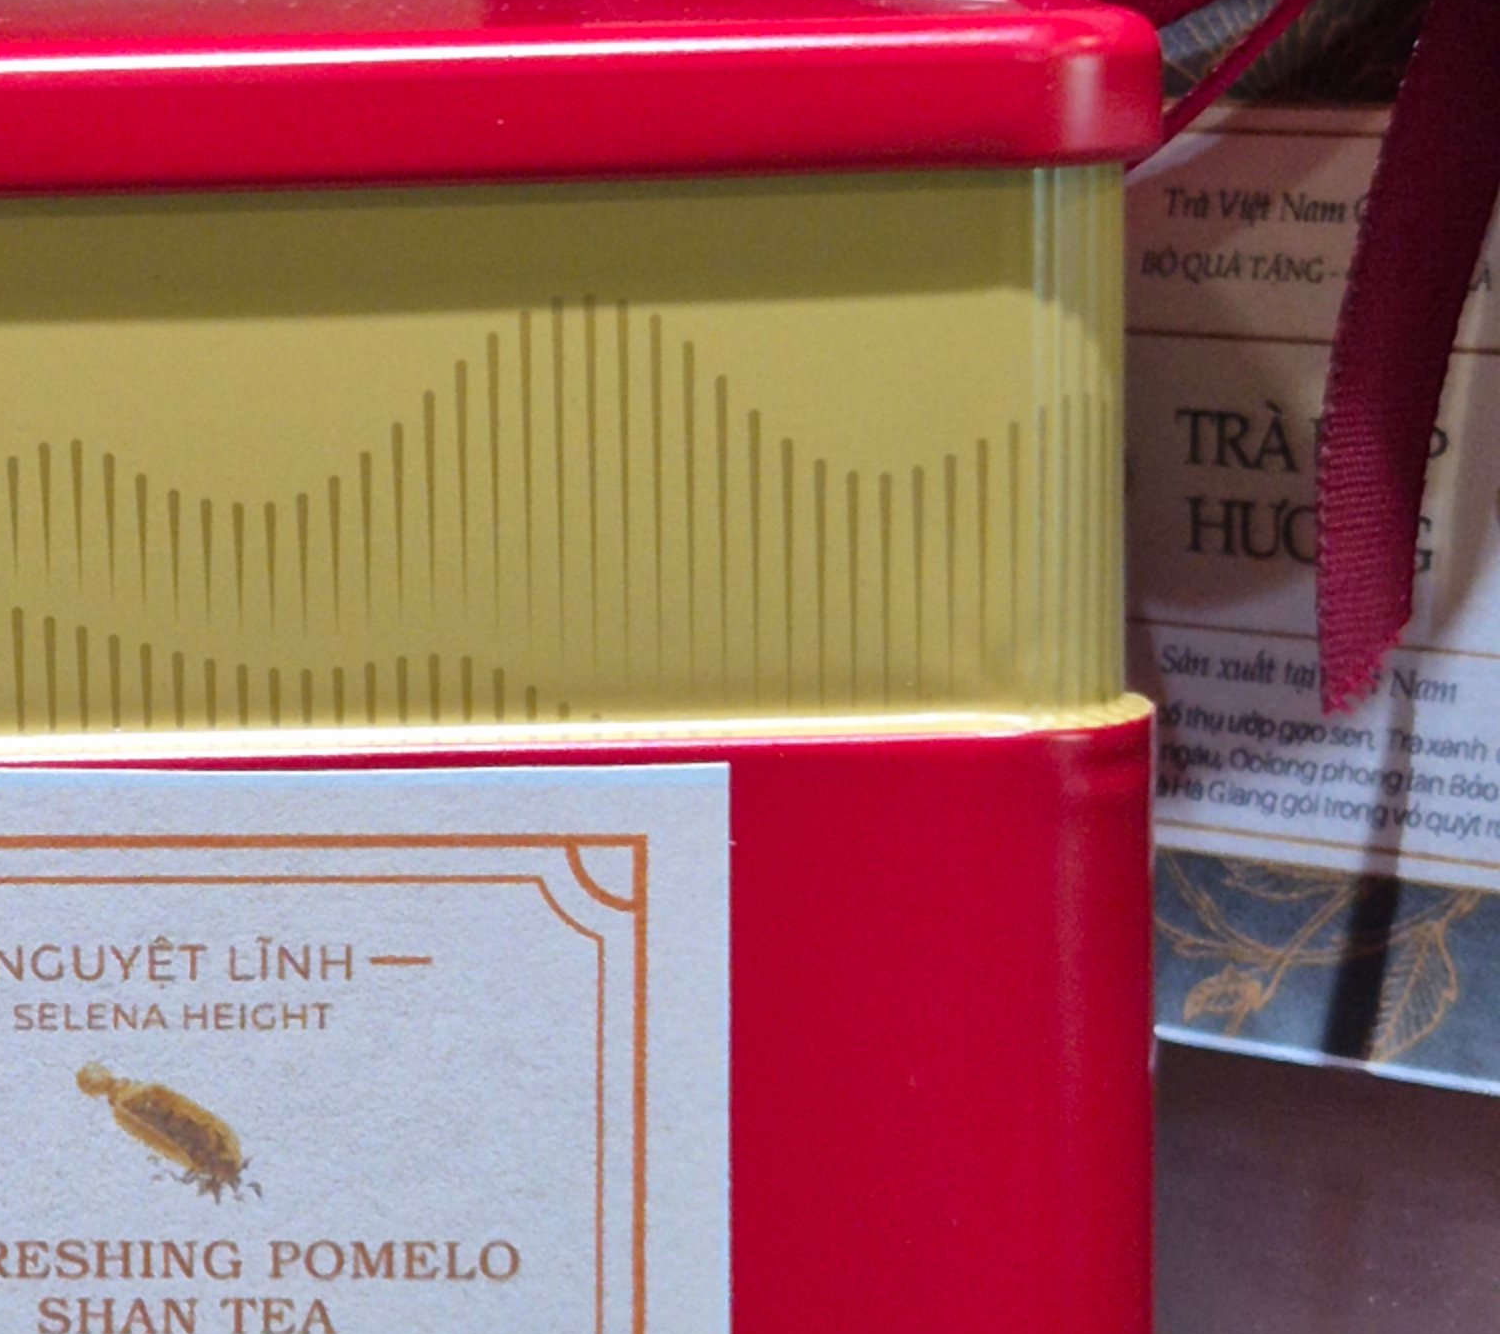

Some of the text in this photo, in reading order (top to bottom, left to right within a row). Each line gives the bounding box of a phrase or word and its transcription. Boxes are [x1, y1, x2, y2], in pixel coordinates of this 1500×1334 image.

[1219, 190, 1270, 226] Việt
[1279, 192, 1345, 224] Nam
[1174, 400, 1296, 472] TRÀ
[1216, 648, 1274, 684] xuất
[1390, 668, 1457, 704] Nam
[1426, 737, 1487, 761] xanh
[1229, 747, 1318, 785] Oolong
[1321, 760, 1403, 798] phong
[1207, 780, 1278, 816] Giang
[1324, 800, 1389, 830] trong
[229, 935, 354, 982] LĨNH
[13, 1002, 333, 1033] SELENA HEIGHT
[267, 1240, 521, 1281] POMELO
